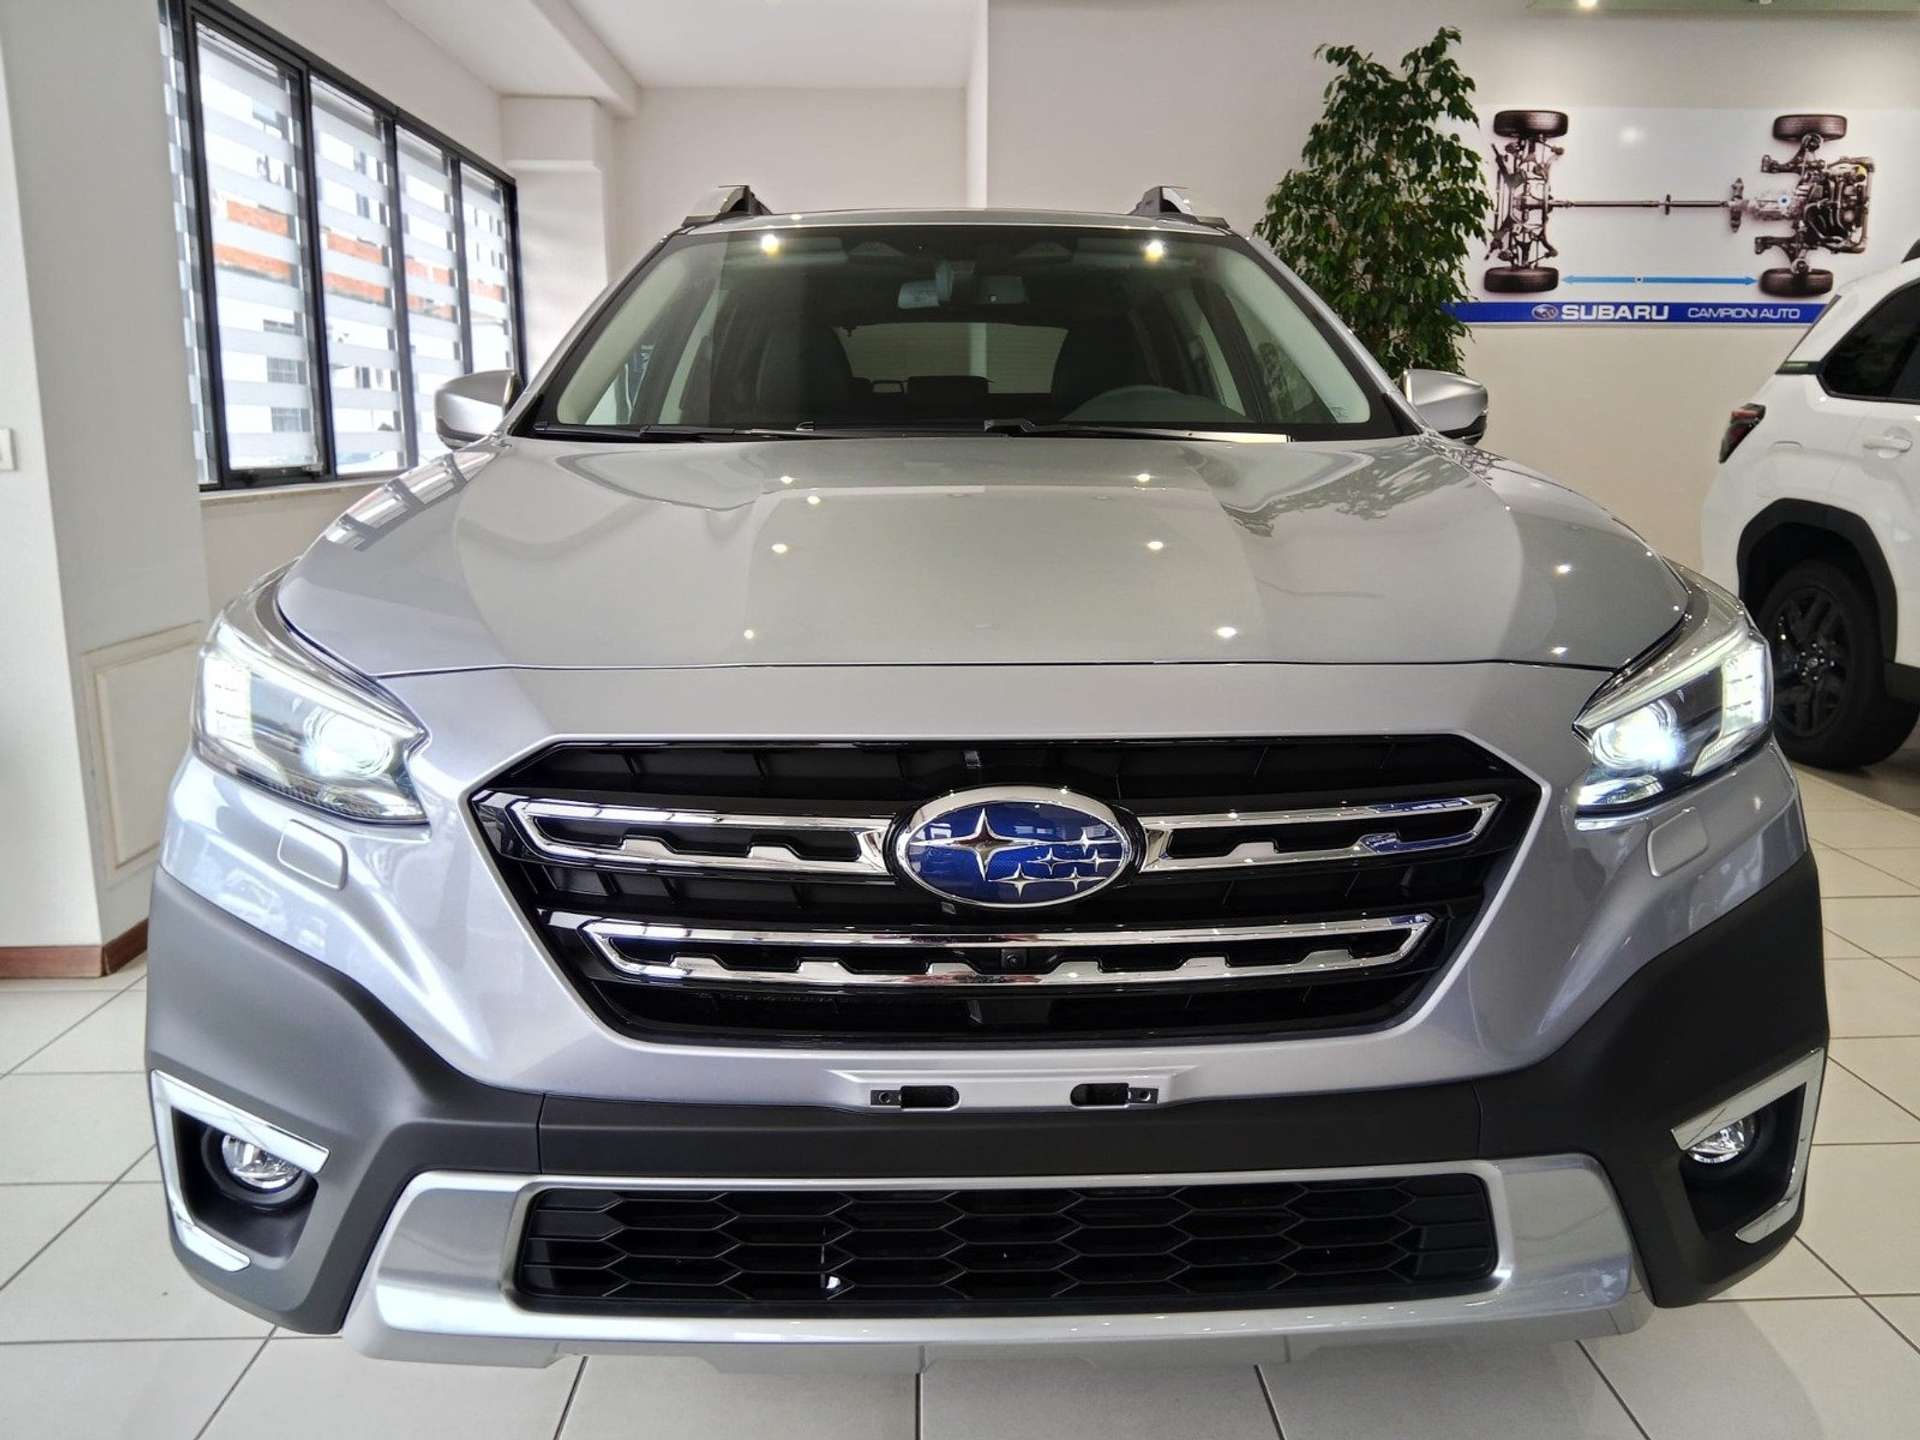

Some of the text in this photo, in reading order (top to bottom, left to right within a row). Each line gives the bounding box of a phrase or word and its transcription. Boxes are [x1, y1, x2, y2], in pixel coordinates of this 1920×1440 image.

[1561, 304, 1801, 320] SUBARU CAMPIONI AUTO
